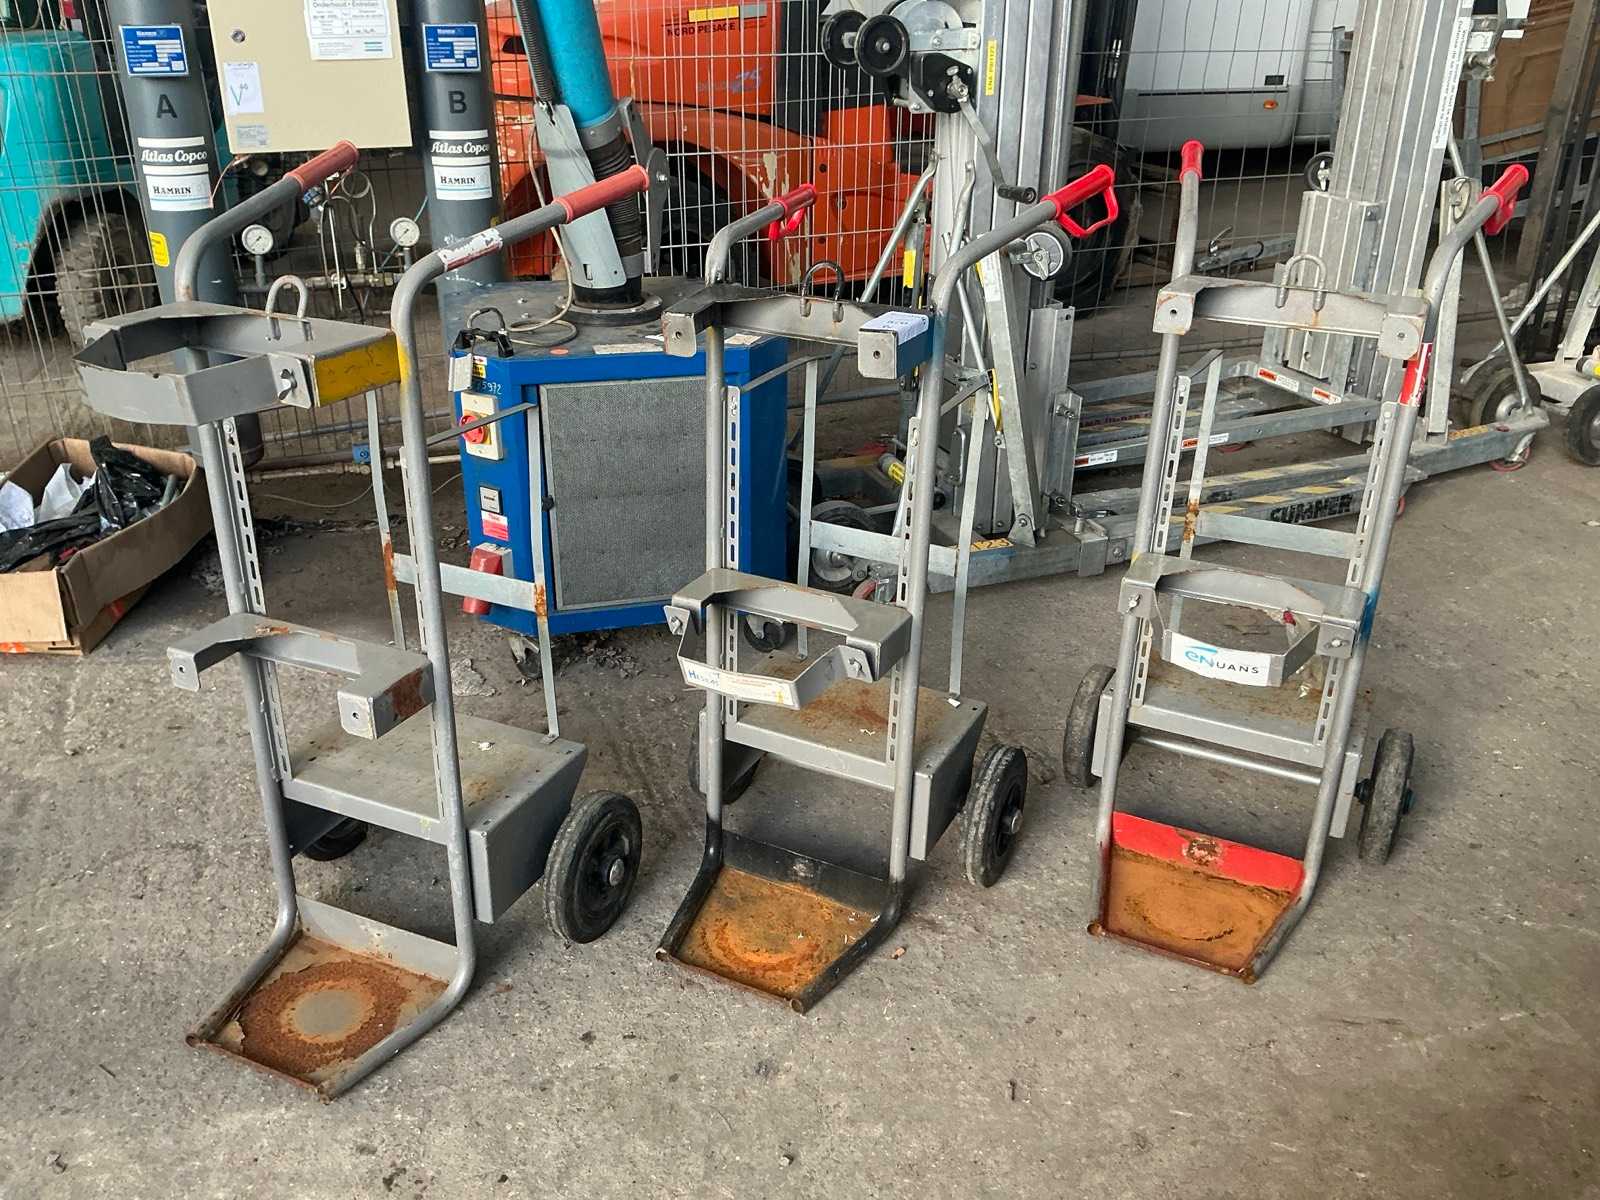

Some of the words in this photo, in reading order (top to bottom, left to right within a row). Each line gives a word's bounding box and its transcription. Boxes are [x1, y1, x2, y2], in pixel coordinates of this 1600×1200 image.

[156, 94, 178, 118] A
[447, 90, 467, 114] B
[141, 149, 173, 162] Atlas
[174, 149, 208, 163] Copco
[432, 142, 463, 154] Atlas
